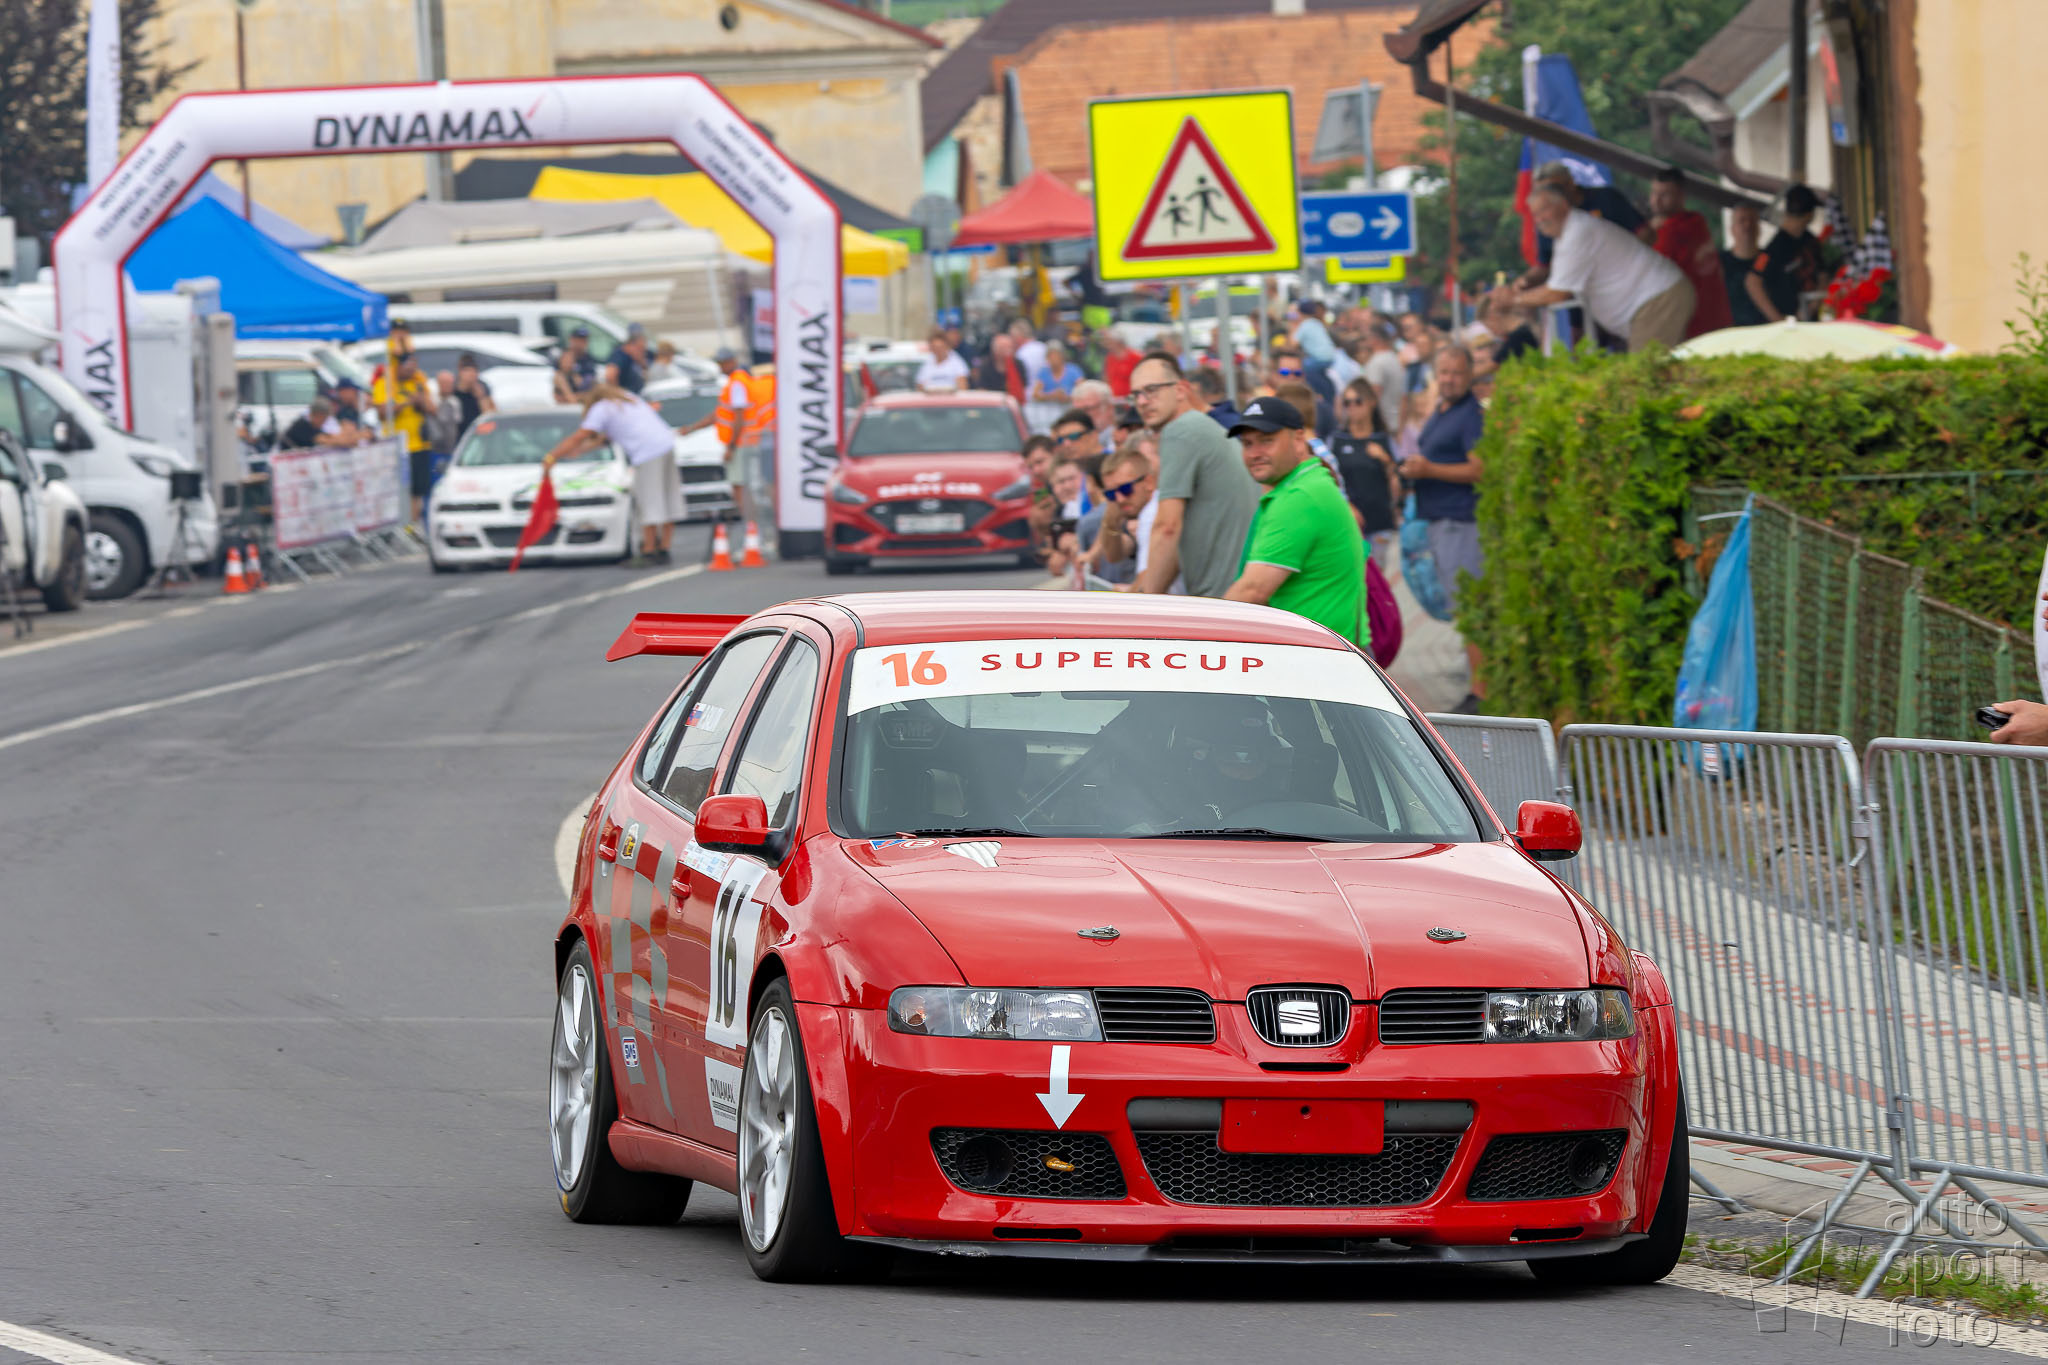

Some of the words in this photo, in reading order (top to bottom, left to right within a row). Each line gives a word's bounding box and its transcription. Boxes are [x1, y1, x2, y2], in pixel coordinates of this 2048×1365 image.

[313, 107, 532, 149] DYNAMAX
[800, 312, 829, 501] DYNAMAX
[881, 650, 947, 687] 16
[980, 651, 1264, 673] SUPERCUP
[715, 879, 751, 1029] 16
